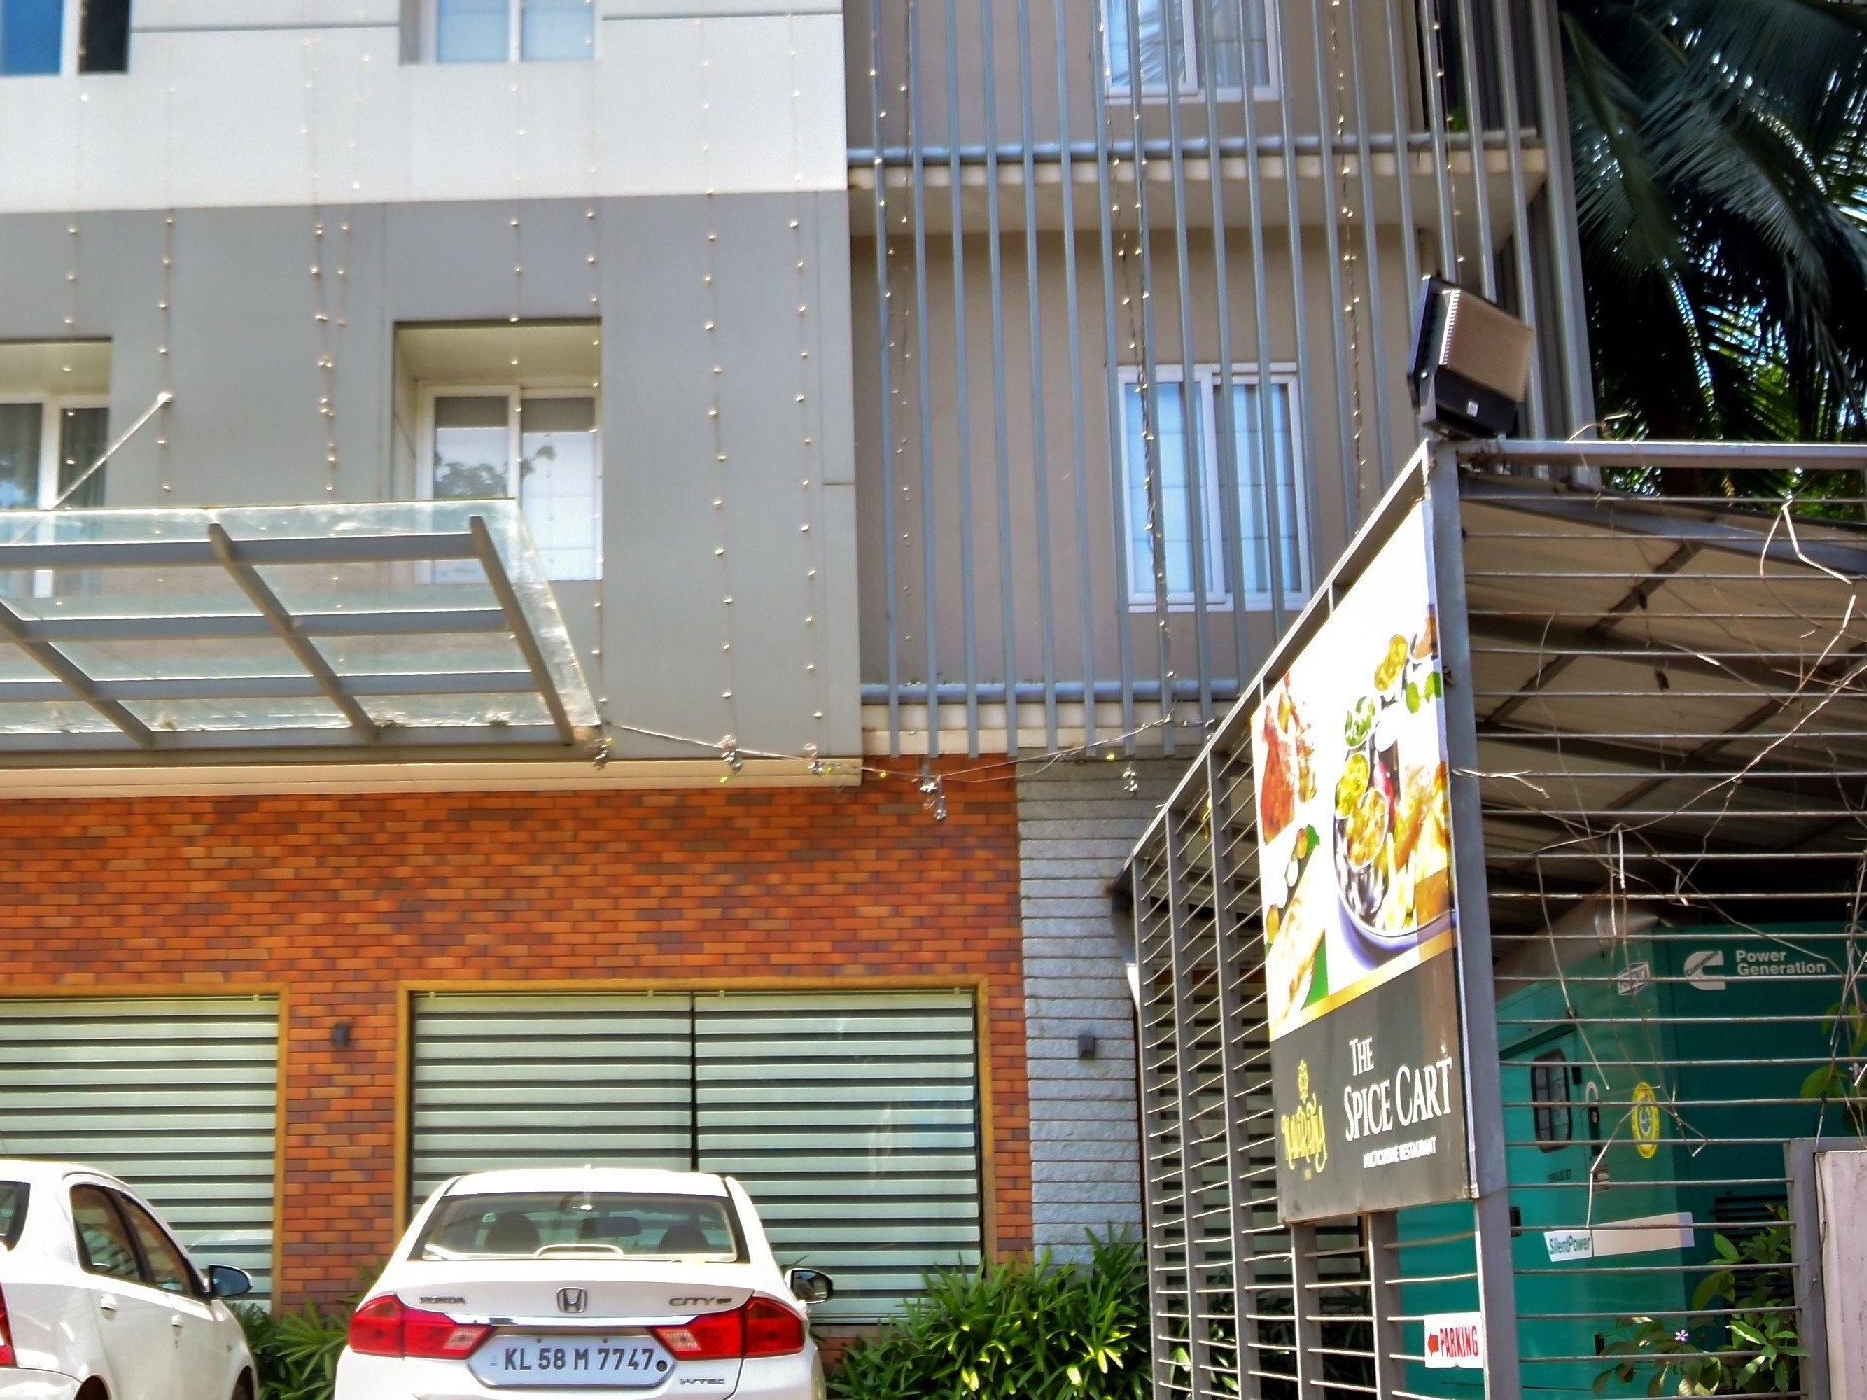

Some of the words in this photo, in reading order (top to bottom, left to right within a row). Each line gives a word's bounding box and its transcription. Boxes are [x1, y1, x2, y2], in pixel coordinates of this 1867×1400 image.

[1736, 950, 1787, 962] Power
[1737, 961, 1827, 976] Generation
[1349, 1036, 1375, 1077] THE
[1344, 1079, 1394, 1142] SPICE
[1395, 1056, 1453, 1127] CART
[668, 1296, 715, 1307] CITY
[1439, 1325, 1479, 1358] PARKING
[504, 1348, 532, 1371] KL
[537, 1348, 566, 1371] 58
[573, 1348, 589, 1371] M
[597, 1348, 655, 1371] 7747
